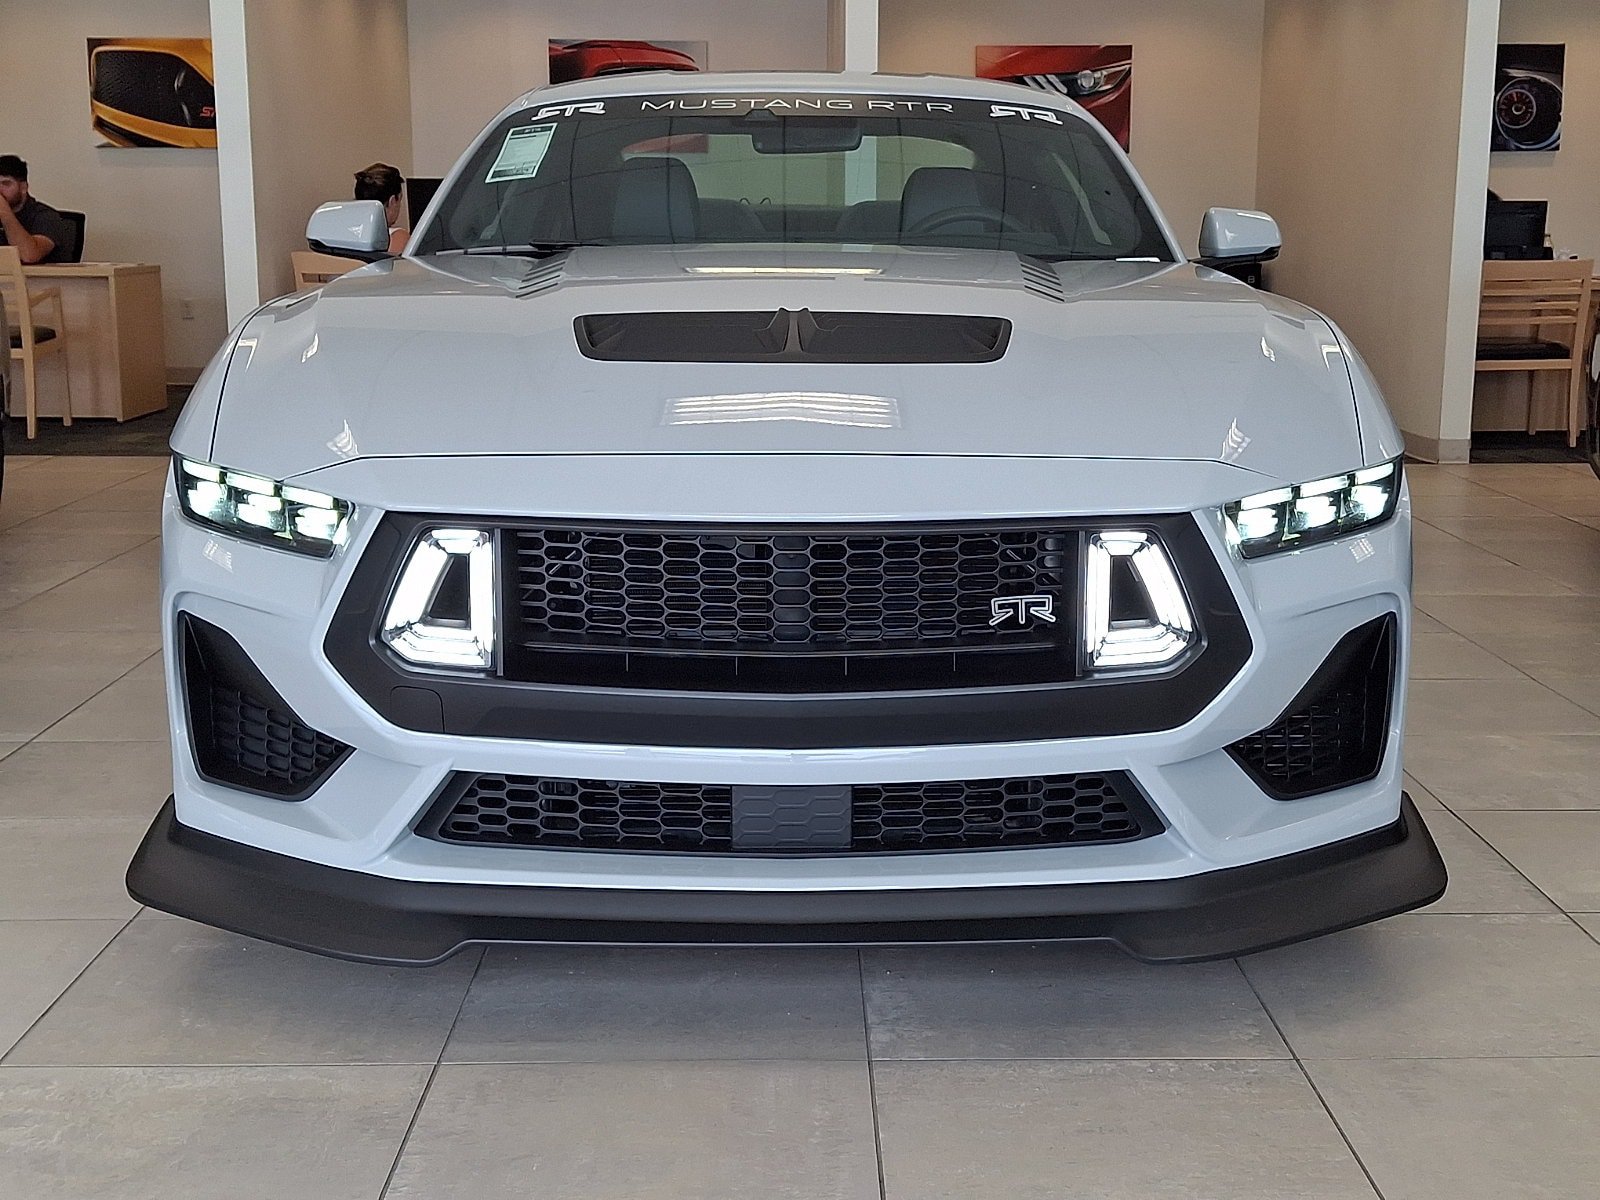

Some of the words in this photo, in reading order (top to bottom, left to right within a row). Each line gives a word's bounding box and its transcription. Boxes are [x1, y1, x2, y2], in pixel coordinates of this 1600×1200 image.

[641, 98, 853, 111] MUSTANG
[867, 101, 954, 113] RTR
[988, 594, 1057, 627] RTR
